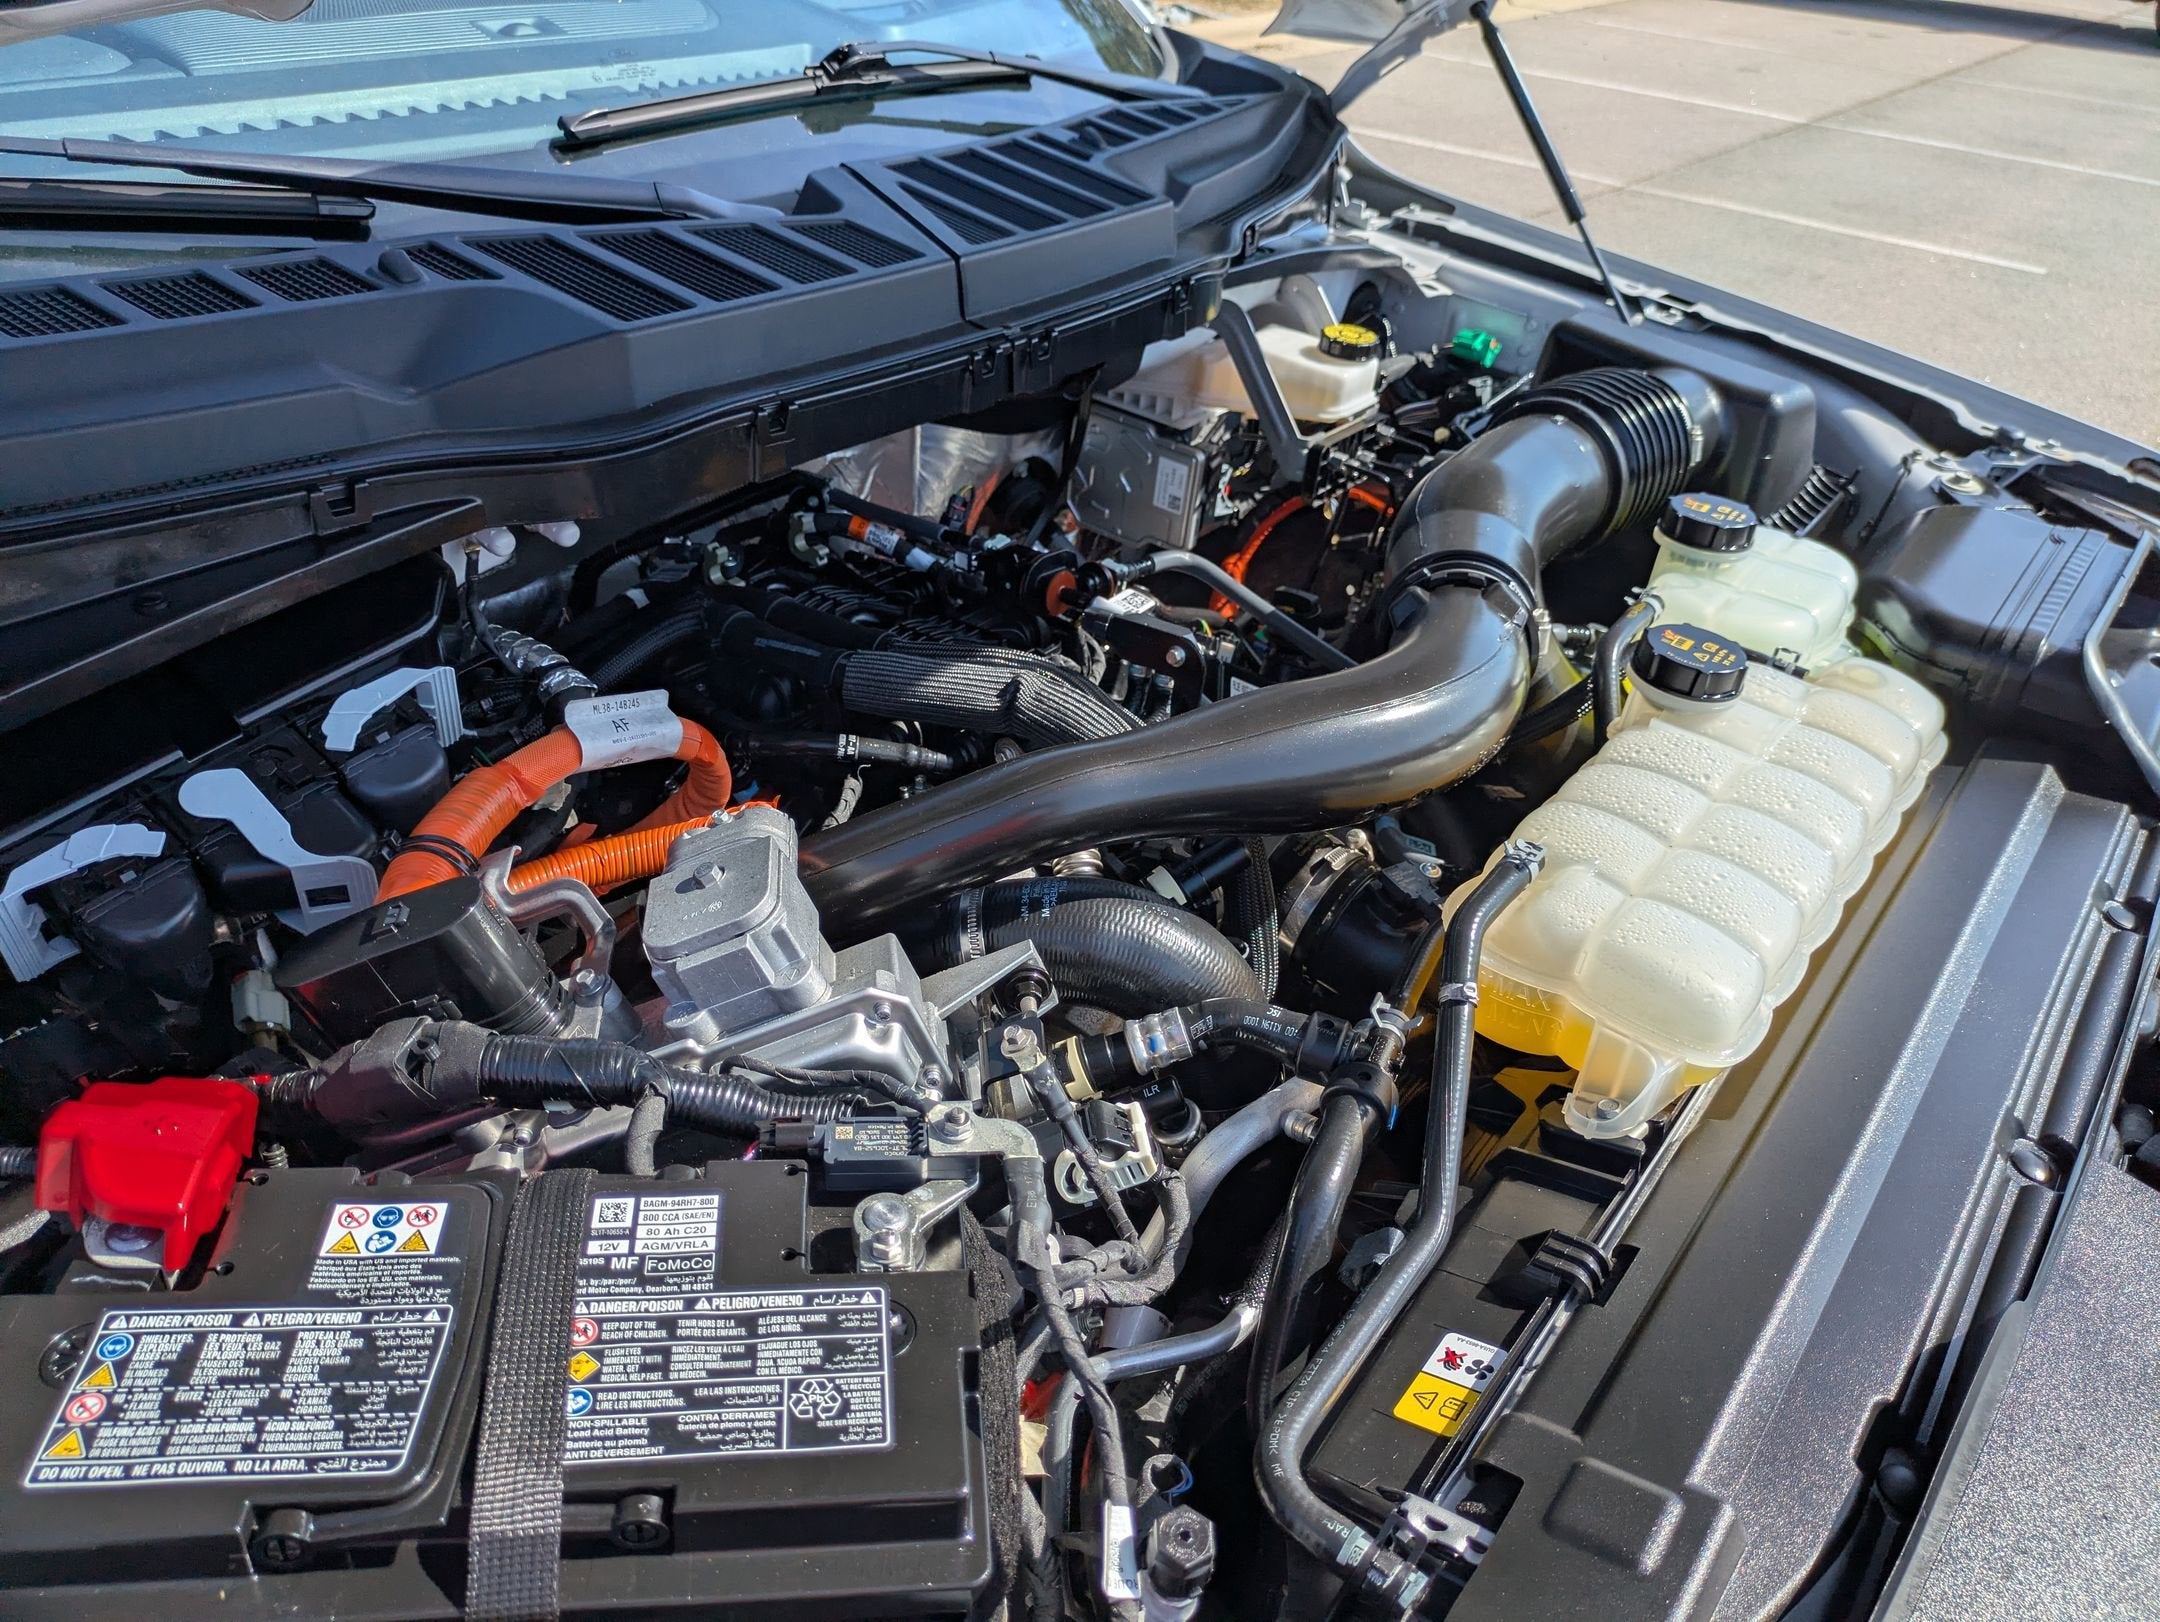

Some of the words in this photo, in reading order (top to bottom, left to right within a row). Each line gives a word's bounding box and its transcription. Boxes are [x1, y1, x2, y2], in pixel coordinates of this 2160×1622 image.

[612, 718, 630, 733] AF
[1266, 1008, 1282, 1018] ISC
[1143, 1084, 1161, 1098] ILR
[643, 1198, 715, 1208] BAGM-94RH7-800
[643, 1213, 659, 1222] 800
[661, 1212, 680, 1221] CCA
[682, 1210, 715, 1221] (SAE/EN)
[646, 1228, 660, 1236] 80
[664, 1227, 680, 1236] Ah
[684, 1226, 707, 1235] C20
[598, 1243, 620, 1252] 12V
[641, 1240, 710, 1251] AGM/VRLA
[611, 1257, 640, 1270] MF
[648, 1258, 713, 1270] FoMoCo
[589, 1287, 609, 1295] Motor
[611, 1286, 645, 1295] Company,
[646, 1284, 681, 1293] Dearborn,
[590, 1300, 684, 1314] DANGER/POISON
[712, 1295, 804, 1310] PELIGRO/VENENO
[129, 1314, 232, 1328] DANGER/POISON
[262, 1312, 362, 1327] PELIGRO/VENENO
[786, 1315, 798, 1323] DEL
[799, 1313, 828, 1323] ALCANCE
[603, 1322, 619, 1331] KEEP
[620, 1322, 632, 1330] OUT
[634, 1322, 643, 1330] OF
[645, 1321, 657, 1329] THE
[678, 1320, 698, 1328] TENIR
[699, 1320, 716, 1328] HORS
[717, 1320, 725, 1328] DE
[602, 1331, 624, 1340] REACH
[625, 1331, 633, 1339] OF
[634, 1329, 669, 1338] CHILDREN.
[677, 1326, 702, 1336] PORTÉE
[703, 1328, 716, 1336] DES
[717, 1327, 748, 1336] ENFANTS.
[758, 1326, 767, 1334] DE
[768, 1325, 780, 1333] LOS
[141, 1335, 168, 1345] SHIELD
[207, 1334, 219, 1343] SE
[220, 1332, 262, 1342] PROTÉGER
[299, 1332, 334, 1341] PROTEJA
[336, 1331, 351, 1340] LOS
[137, 1343, 183, 1353] EXPLOSIVE
[205, 1343, 220, 1352] LES
[247, 1342, 263, 1351] LES
[264, 1341, 281, 1350] GAZ
[320, 1340, 336, 1348] LOS
[337, 1339, 364, 1348] GASES
[758, 1341, 789, 1350] ENJUAGUE
[790, 1340, 802, 1349] LOS
[803, 1340, 817, 1348] OJOS
[134, 1352, 160, 1361] GASES
[201, 1351, 246, 1360] EXPLOSIFS
[246, 1351, 280, 1359] PEUVENT
[292, 1348, 342, 1357] EXPLOSIVOS
[605, 1348, 625, 1356] FLUSH
[626, 1347, 642, 1356] EYES
[757, 1348, 808, 1358] INMEDIATAMENTE
[809, 1347, 823, 1356] CON
[290, 1357, 319, 1366] PUEDEN
[320, 1356, 350, 1365] CAUSAR
[603, 1356, 645, 1365] IMMEDIATELY
[646, 1354, 662, 1363] WITH
[130, 1361, 154, 1369] CAUSE
[628, 1364, 640, 1373] GET
[601, 1373, 628, 1382] MEDICAL
[630, 1373, 646, 1381] HELP
[647, 1371, 664, 1380] FAST.
[756, 1367, 769, 1376] CON
[770, 1367, 778, 1375] EL
[212, 1391, 224, 1399] LES
[301, 1387, 332, 1397] CHISPAS
[694, 1388, 710, 1396] LEA
[711, 1387, 724, 1395] LAS
[724, 1384, 783, 1394] INSTRUCCIONES.
[133, 1392, 163, 1401] SPARKS
[598, 1392, 618, 1401] READ
[620, 1390, 675, 1399] INSTRUCTIONS.
[809, 1394, 824, 1403] Pb
[129, 1401, 160, 1410] FLAMES
[209, 1399, 221, 1407] LES
[223, 1398, 260, 1406] FLAMMES
[596, 1401, 614, 1409] LIRE
[615, 1400, 629, 1408] LES
[630, 1398, 687, 1408] INSTRUCTIONS.
[205, 1408, 215, 1416] DE
[216, 1407, 243, 1415] FUMER
[679, 1413, 720, 1423] CONTRA
[722, 1411, 776, 1421] DERRAMES
[206, 1422, 256, 1433] SULFURIQUE
[569, 1418, 648, 1428] NON-SPILLABLE
[720, 1420, 747, 1430] plomo
[261, 1432, 284, 1441] PUEDE
[285, 1431, 312, 1441] CAUSAR
[313, 1430, 344, 1440] CEGUERA
[568, 1429, 590, 1437] Lead
[593, 1428, 612, 1436] Acid
[615, 1427, 650, 1437] Battery
[566, 1440, 602, 1449] Batterie
[618, 1438, 648, 1448] plomb
[565, 1450, 588, 1459] ANTI
[590, 1446, 664, 1458] DÉVERSEMENT
[132, 1465, 150, 1477] NE
[151, 1464, 176, 1476] PAS
[178, 1462, 227, 1475] OUVRIR.
[235, 1460, 253, 1472] NO
[254, 1460, 271, 1472] LA
[272, 1459, 308, 1472] ABRA.
[39, 1468, 60, 1480] DO
[61, 1467, 84, 1479] NOT
[88, 1466, 125, 1479] OPEN.
